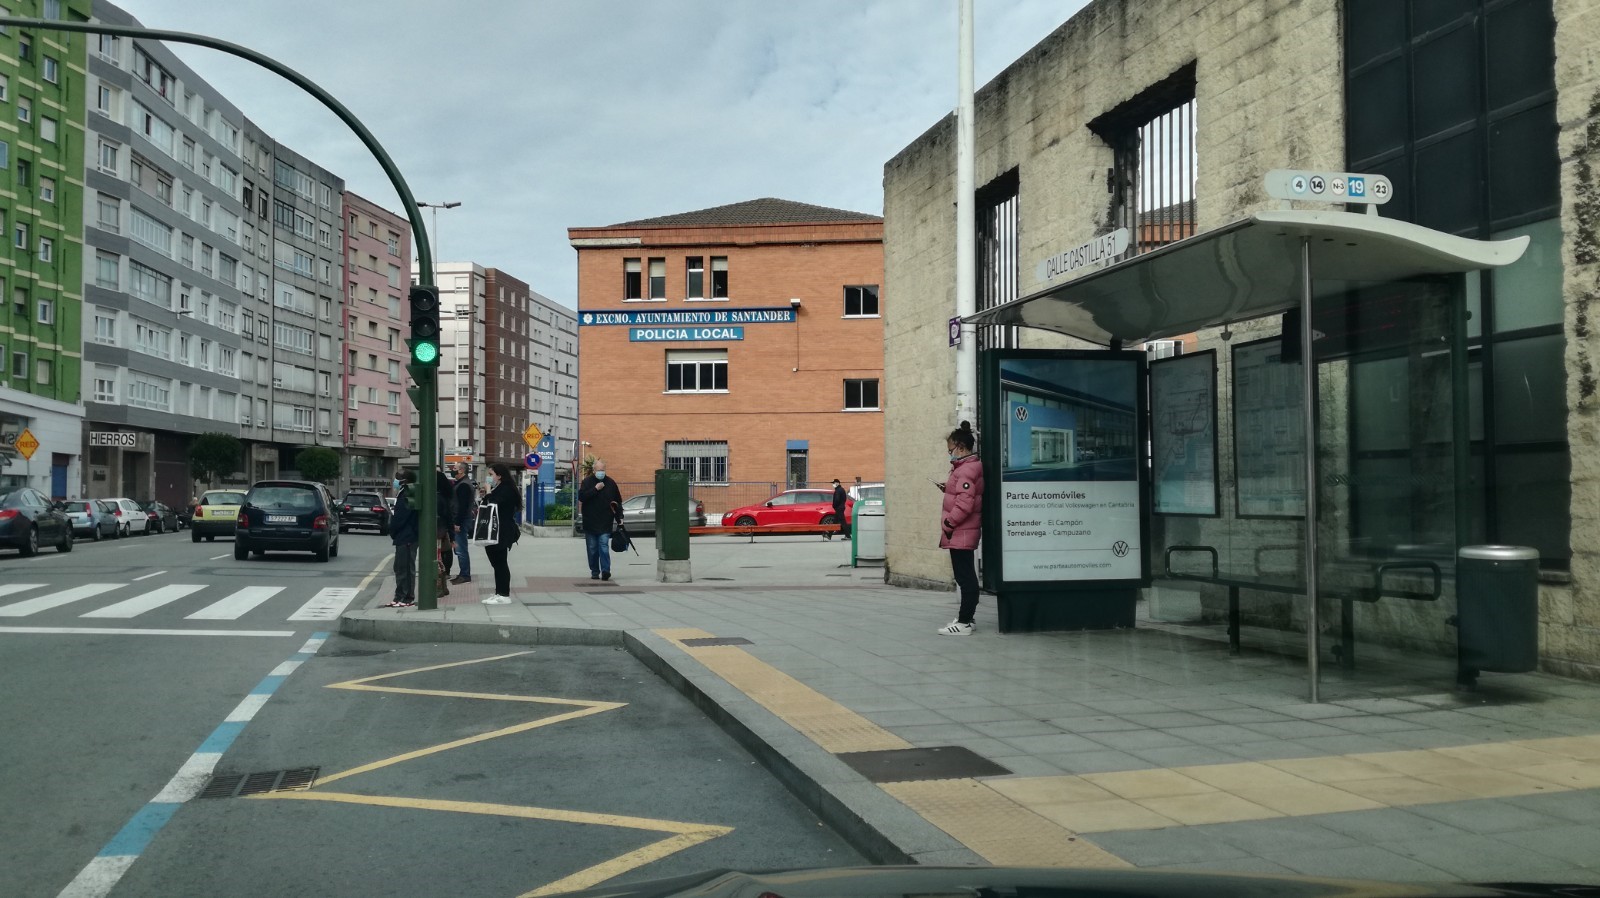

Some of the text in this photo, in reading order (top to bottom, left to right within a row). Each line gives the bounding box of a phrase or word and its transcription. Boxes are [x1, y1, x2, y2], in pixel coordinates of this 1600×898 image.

[1296, 181, 1303, 189] 4
[1312, 181, 1323, 189] 14
[1349, 180, 1364, 194] 19
[1375, 185, 1387, 194] 23
[1046, 234, 1116, 278] CALLE CASTILLA 51
[596, 311, 791, 324] EXCMO. AYUNTAMIENTO DE SANTANDER
[636, 328, 738, 340] POLICIA LOCAL
[90, 432, 135, 445] HIERROS
[1006, 490, 1086, 500] Parte Automóviles
[1007, 529, 1047, 538] Torrelavega
[1052, 529, 1092, 537] Campuzano
